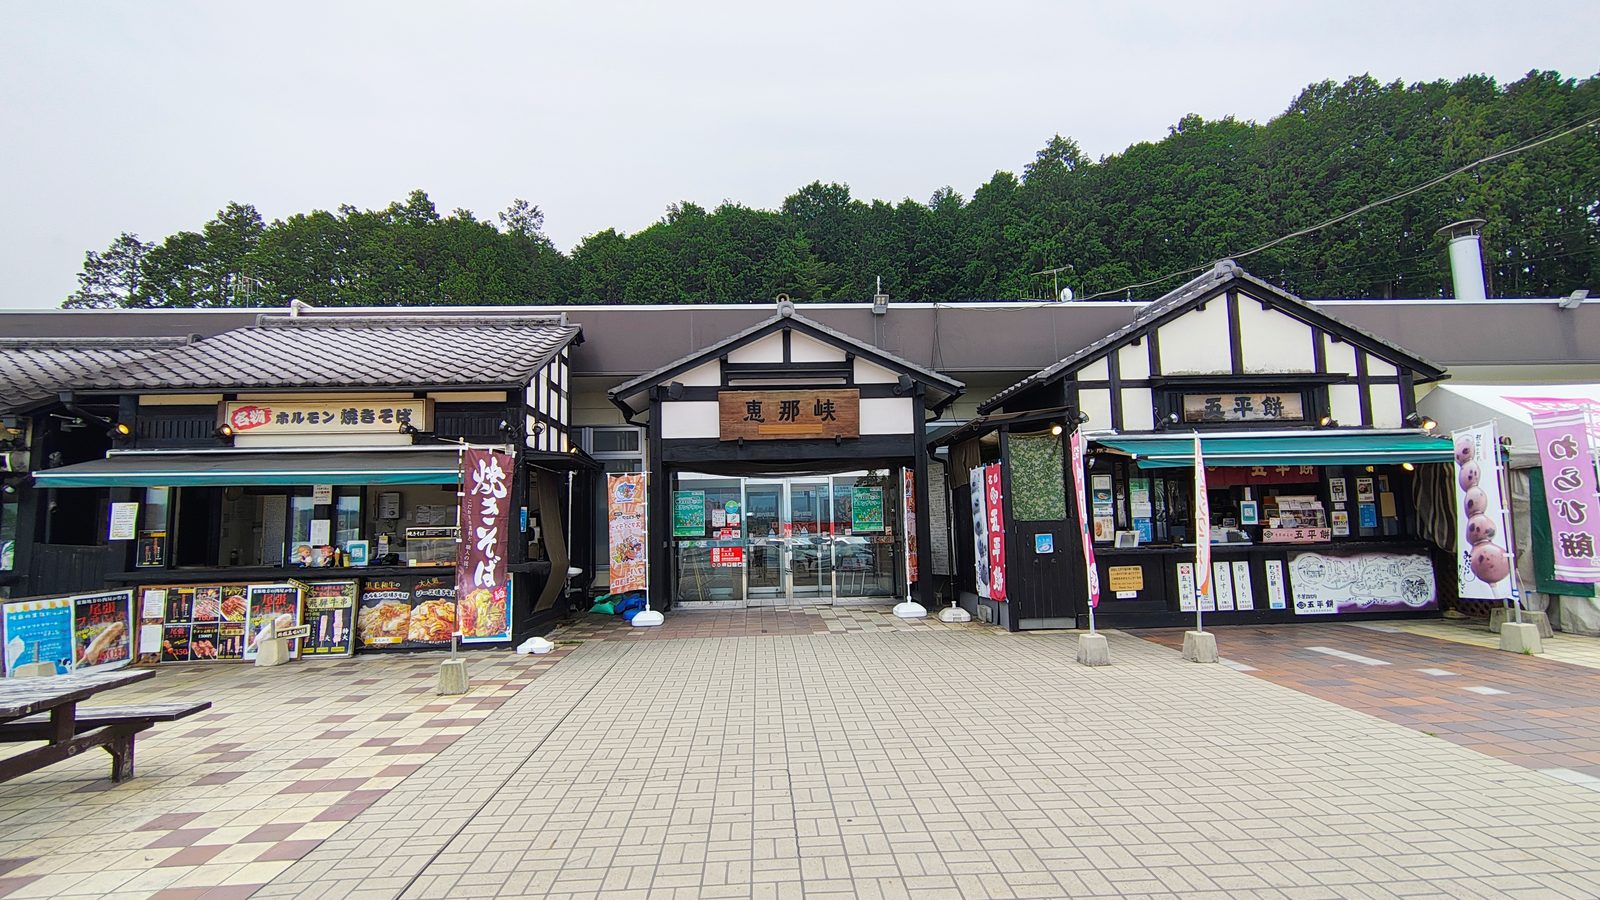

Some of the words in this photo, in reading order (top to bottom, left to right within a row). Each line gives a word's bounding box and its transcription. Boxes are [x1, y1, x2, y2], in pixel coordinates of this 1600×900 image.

[235, 409, 265, 426] 名物
[276, 411, 335, 424] ホルモン
[341, 408, 413, 425] 焼きそば
[743, 399, 836, 423] 恵那峡
[1203, 396, 1284, 419] 五平餅
[471, 456, 508, 588] 焼きそば
[1294, 529, 1330, 539] 五平餅
[1307, 600, 1334, 609] 五平餅
